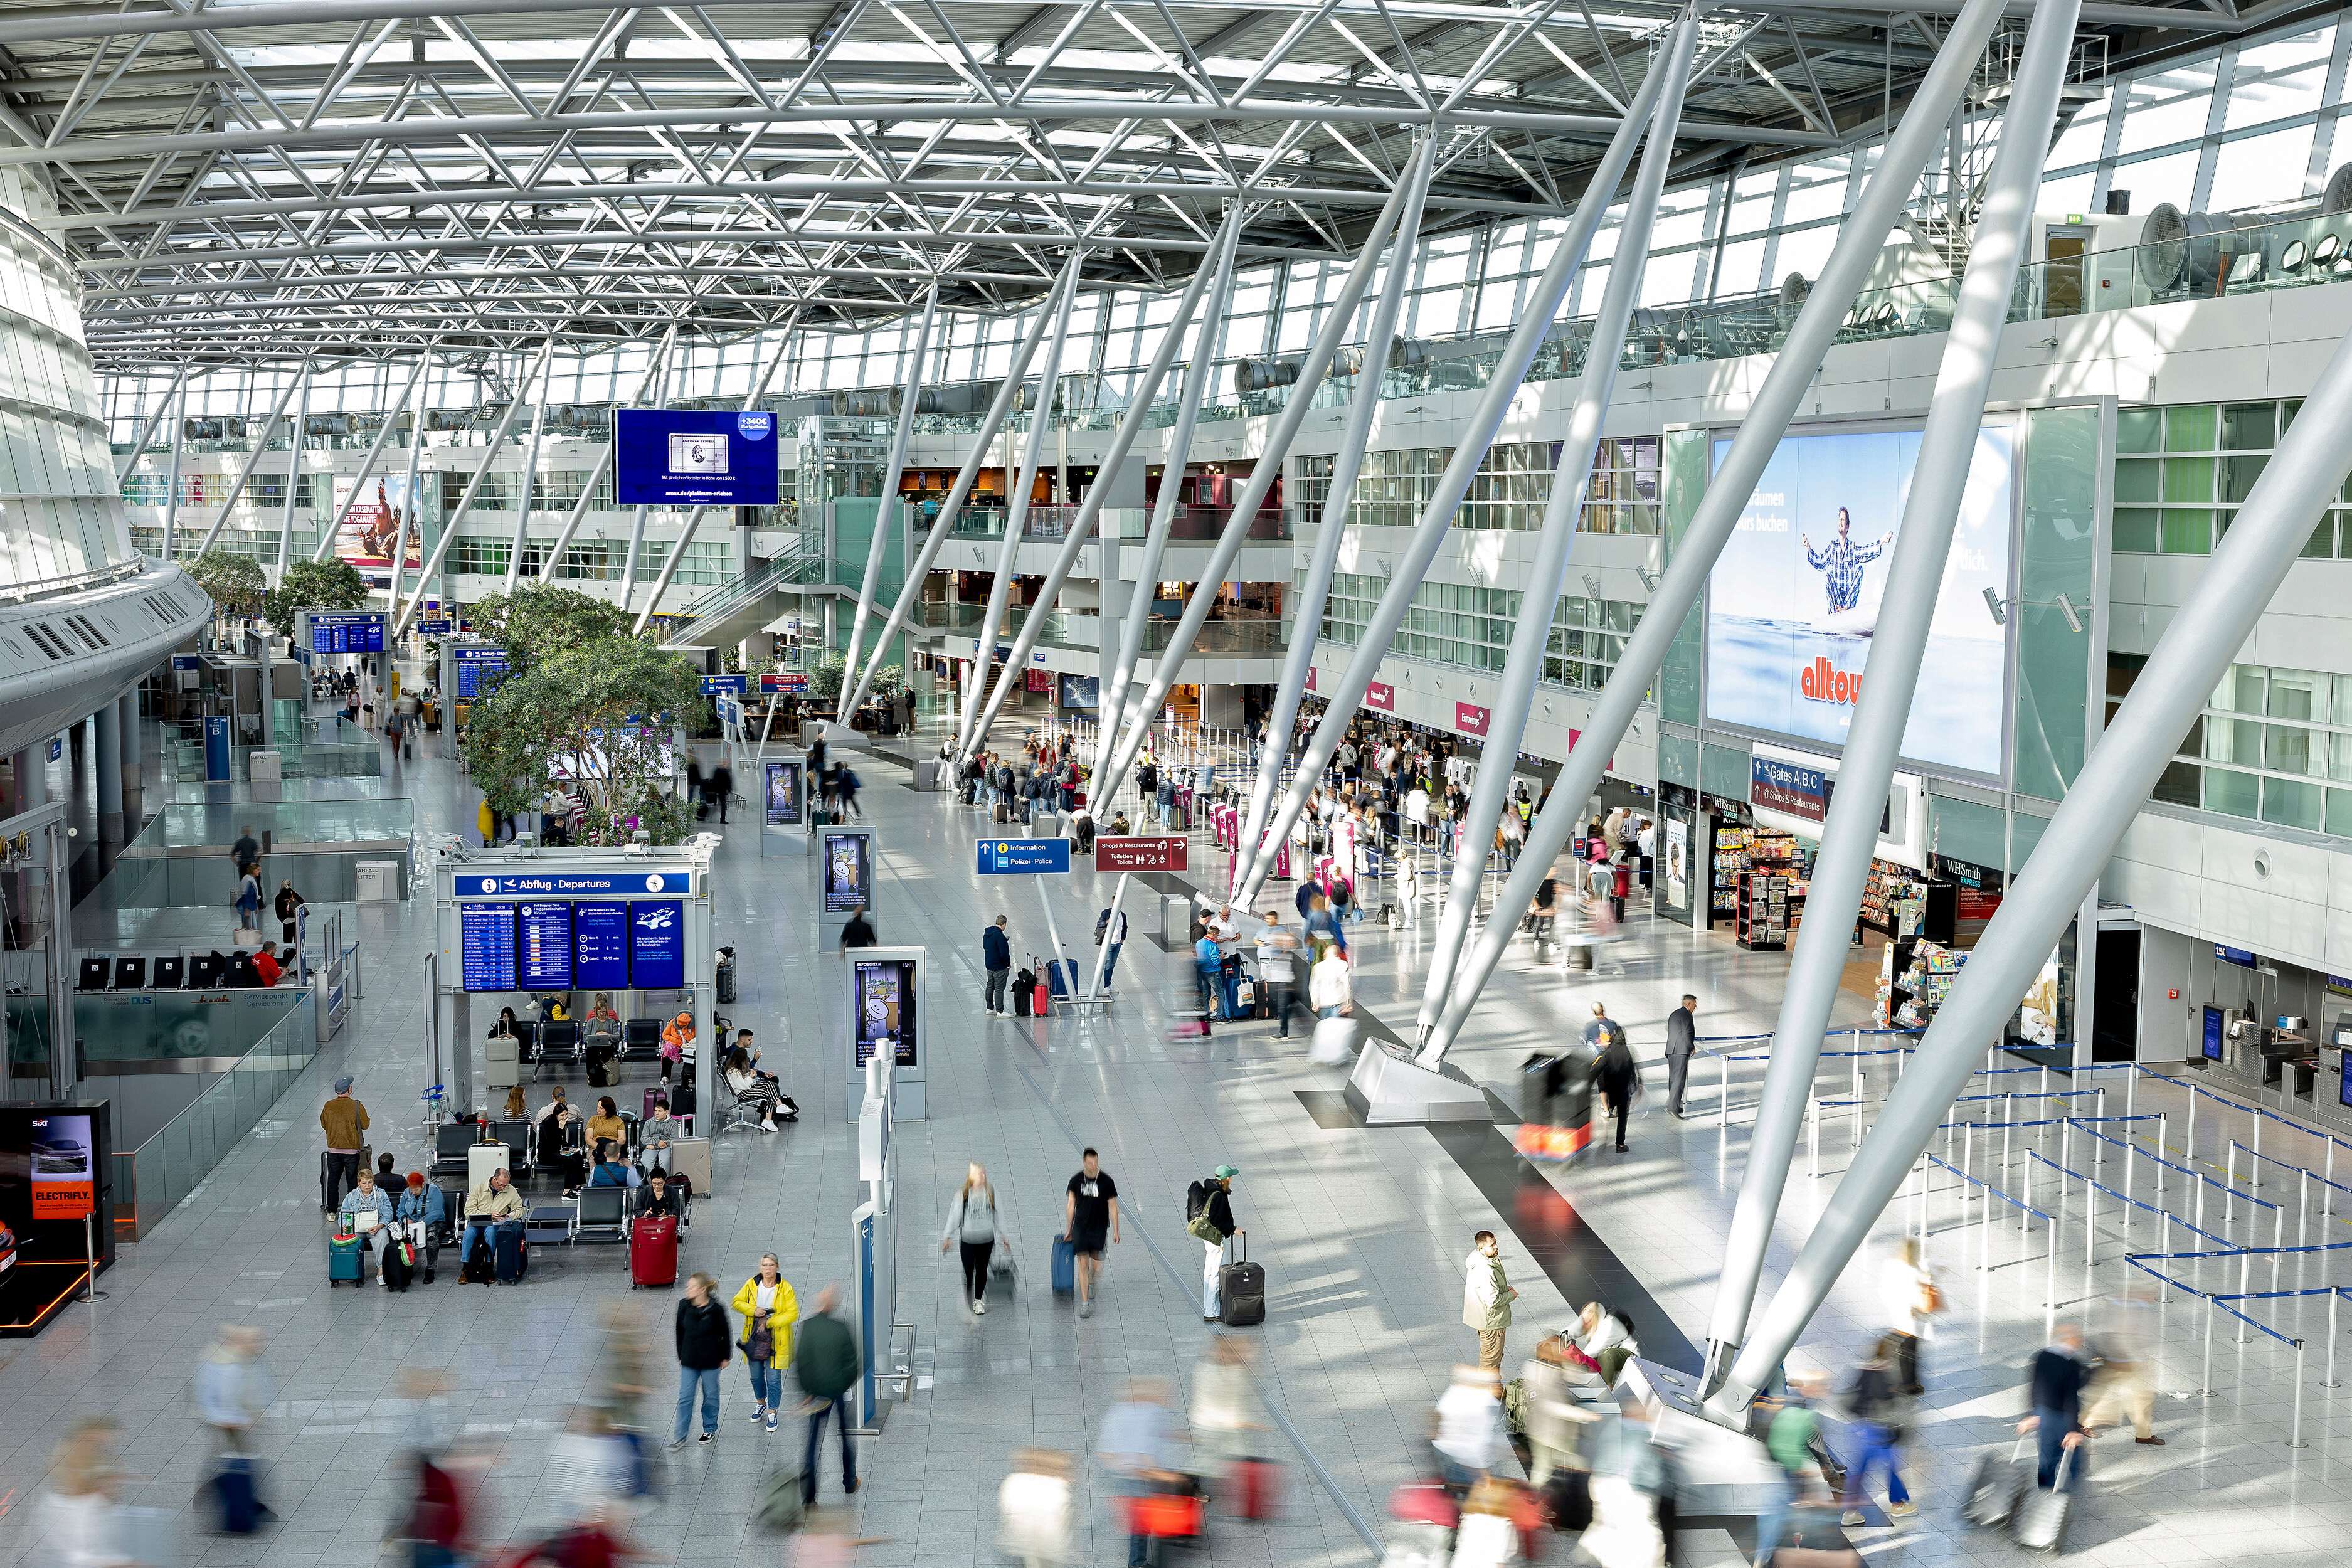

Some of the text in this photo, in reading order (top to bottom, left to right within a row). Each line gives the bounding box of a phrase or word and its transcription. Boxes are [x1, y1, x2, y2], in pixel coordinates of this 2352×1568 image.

[741, 417, 767, 425] +340€
[1747, 488, 1784, 506] räumen
[351, 515, 376, 524] YOGAMATTE
[1756, 512, 1788, 532] buchen
[1801, 655, 1863, 705] alltou
[1461, 712, 1480, 728] Eurowings
[213, 727, 220, 735] B
[1771, 765, 1818, 790] Gates A,B,C
[1714, 797, 1737, 813] WHSmith
[1769, 790, 1820, 812] Shops & Restaurants
[1724, 810, 1737, 819] EXPRESS
[1668, 830, 1685, 846] LESEN
[1947, 859, 1981, 880] WHSmith
[519, 879, 610, 890] Abflug Departures
[1961, 876, 1981, 888] EXPRESS
[131, 996, 152, 1005] DUS
[36, 1192, 90, 1200] ELECTRIFLY.
